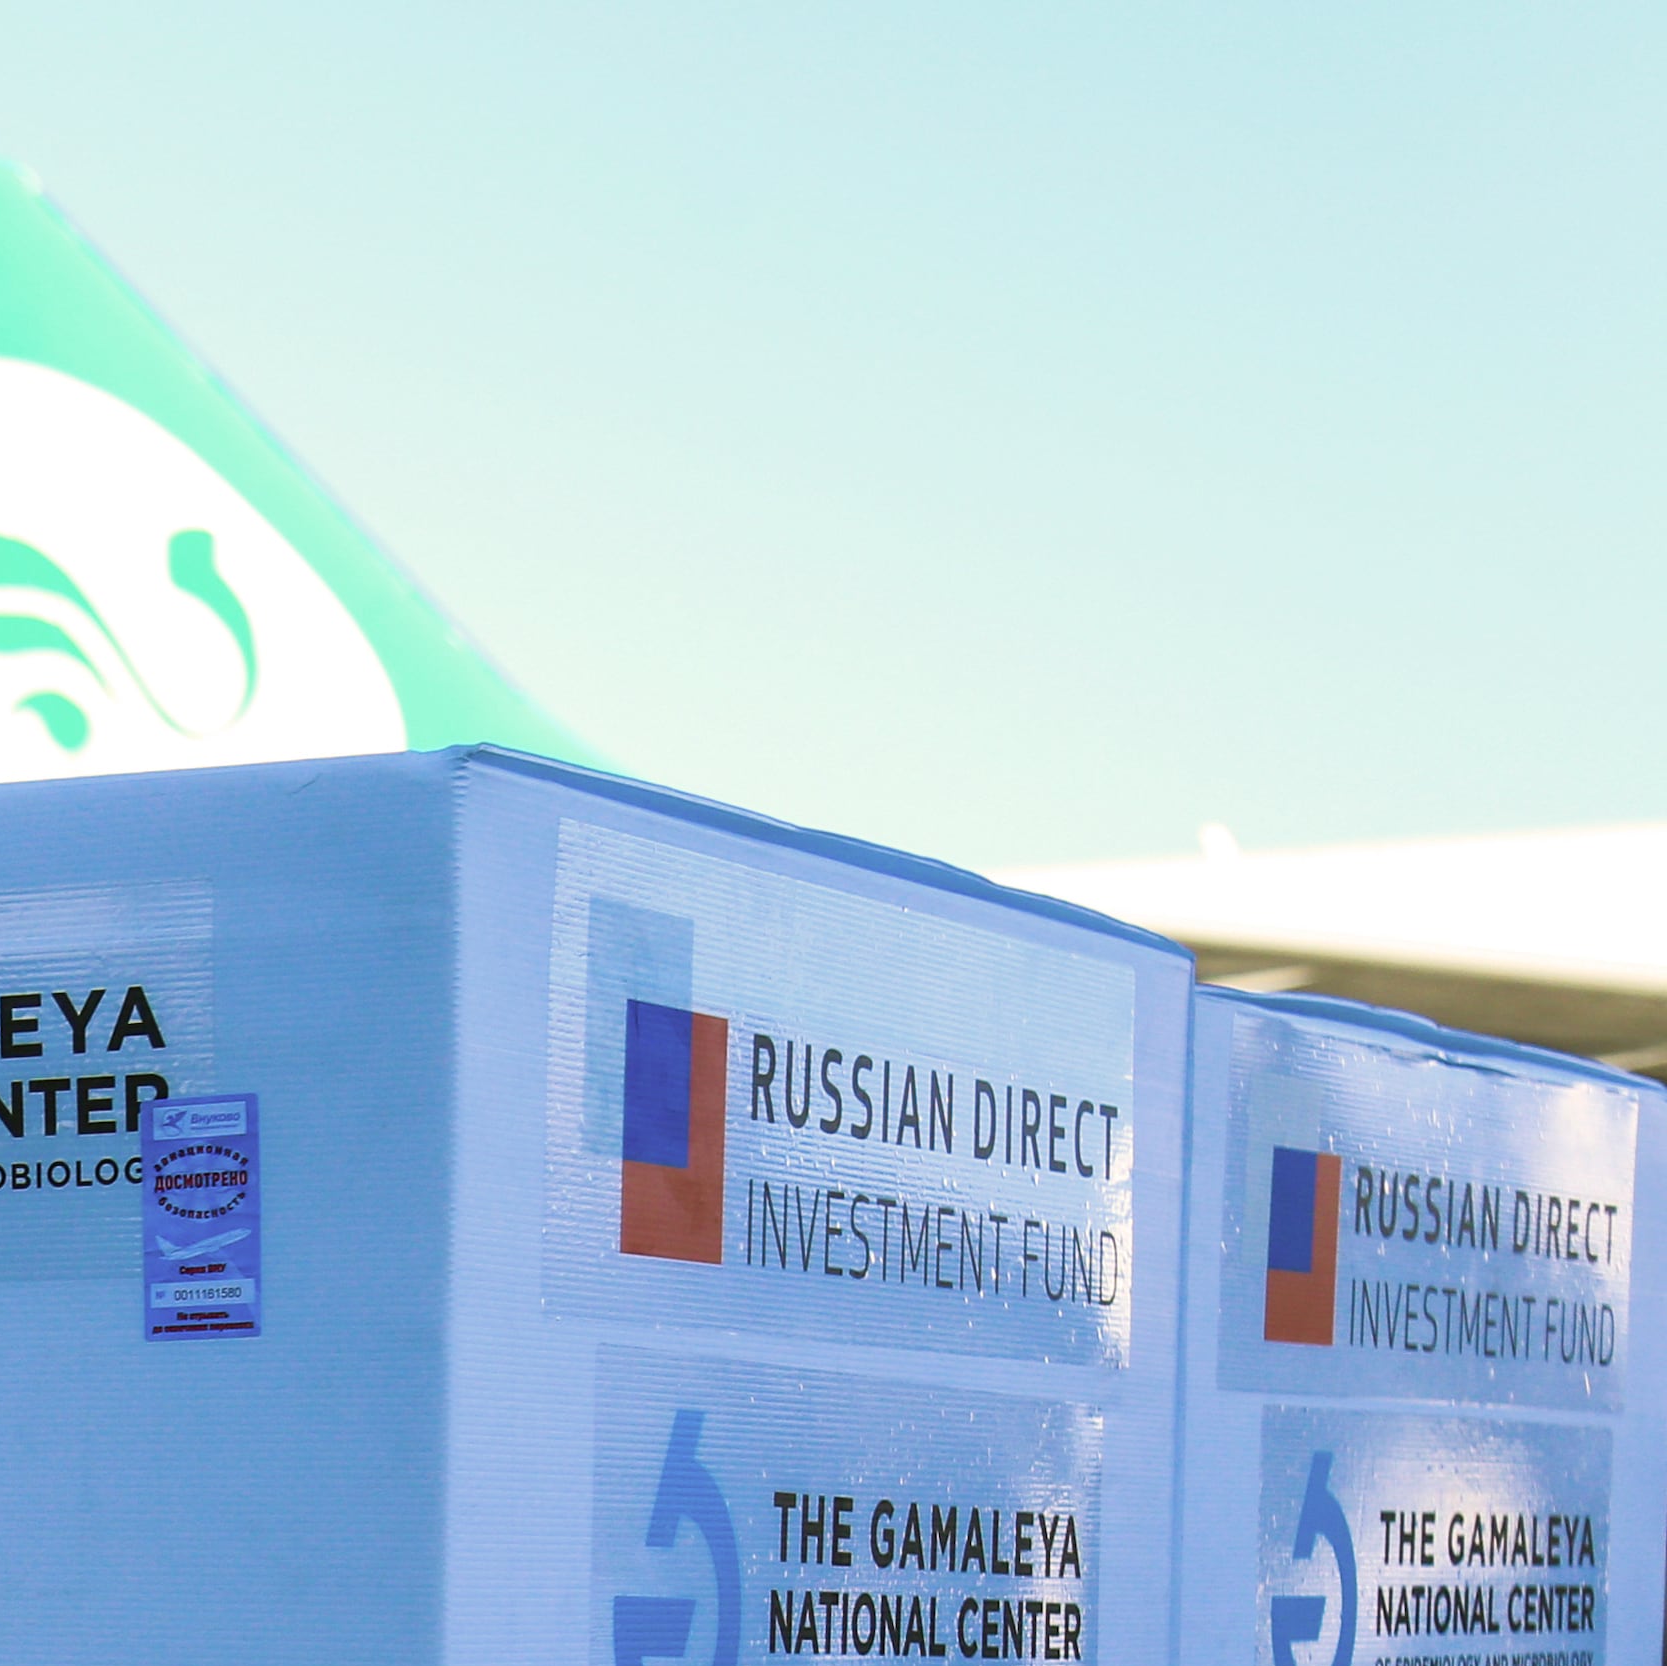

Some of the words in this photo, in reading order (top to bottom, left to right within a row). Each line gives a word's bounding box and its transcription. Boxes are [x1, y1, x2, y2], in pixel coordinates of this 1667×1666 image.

[752, 1033, 953, 1154] RUSSIAN
[974, 1079, 1118, 1180] DIRECT
[155, 1170, 248, 1193] ДОСМОТРЕНО
[1355, 1166, 1500, 1250] RUSSIAN
[1513, 1190, 1617, 1265] DIRECT
[747, 1179, 1008, 1294] INVESTMENT
[1023, 1220, 1117, 1305] FUND
[1350, 1278, 1536, 1360] INVESTMENT
[1545, 1297, 1614, 1366] FUND
[774, 1492, 853, 1566] THE
[871, 1500, 1081, 1578] GAMALEYA
[1381, 1510, 1435, 1566] THE
[1448, 1512, 1595, 1567] GAMALEYA
[769, 1590, 946, 1657] NATIONAL
[958, 1597, 1081, 1660] CENTER
[1377, 1585, 1499, 1637] NATIONAL
[1508, 1584, 1594, 1633] CENTER
